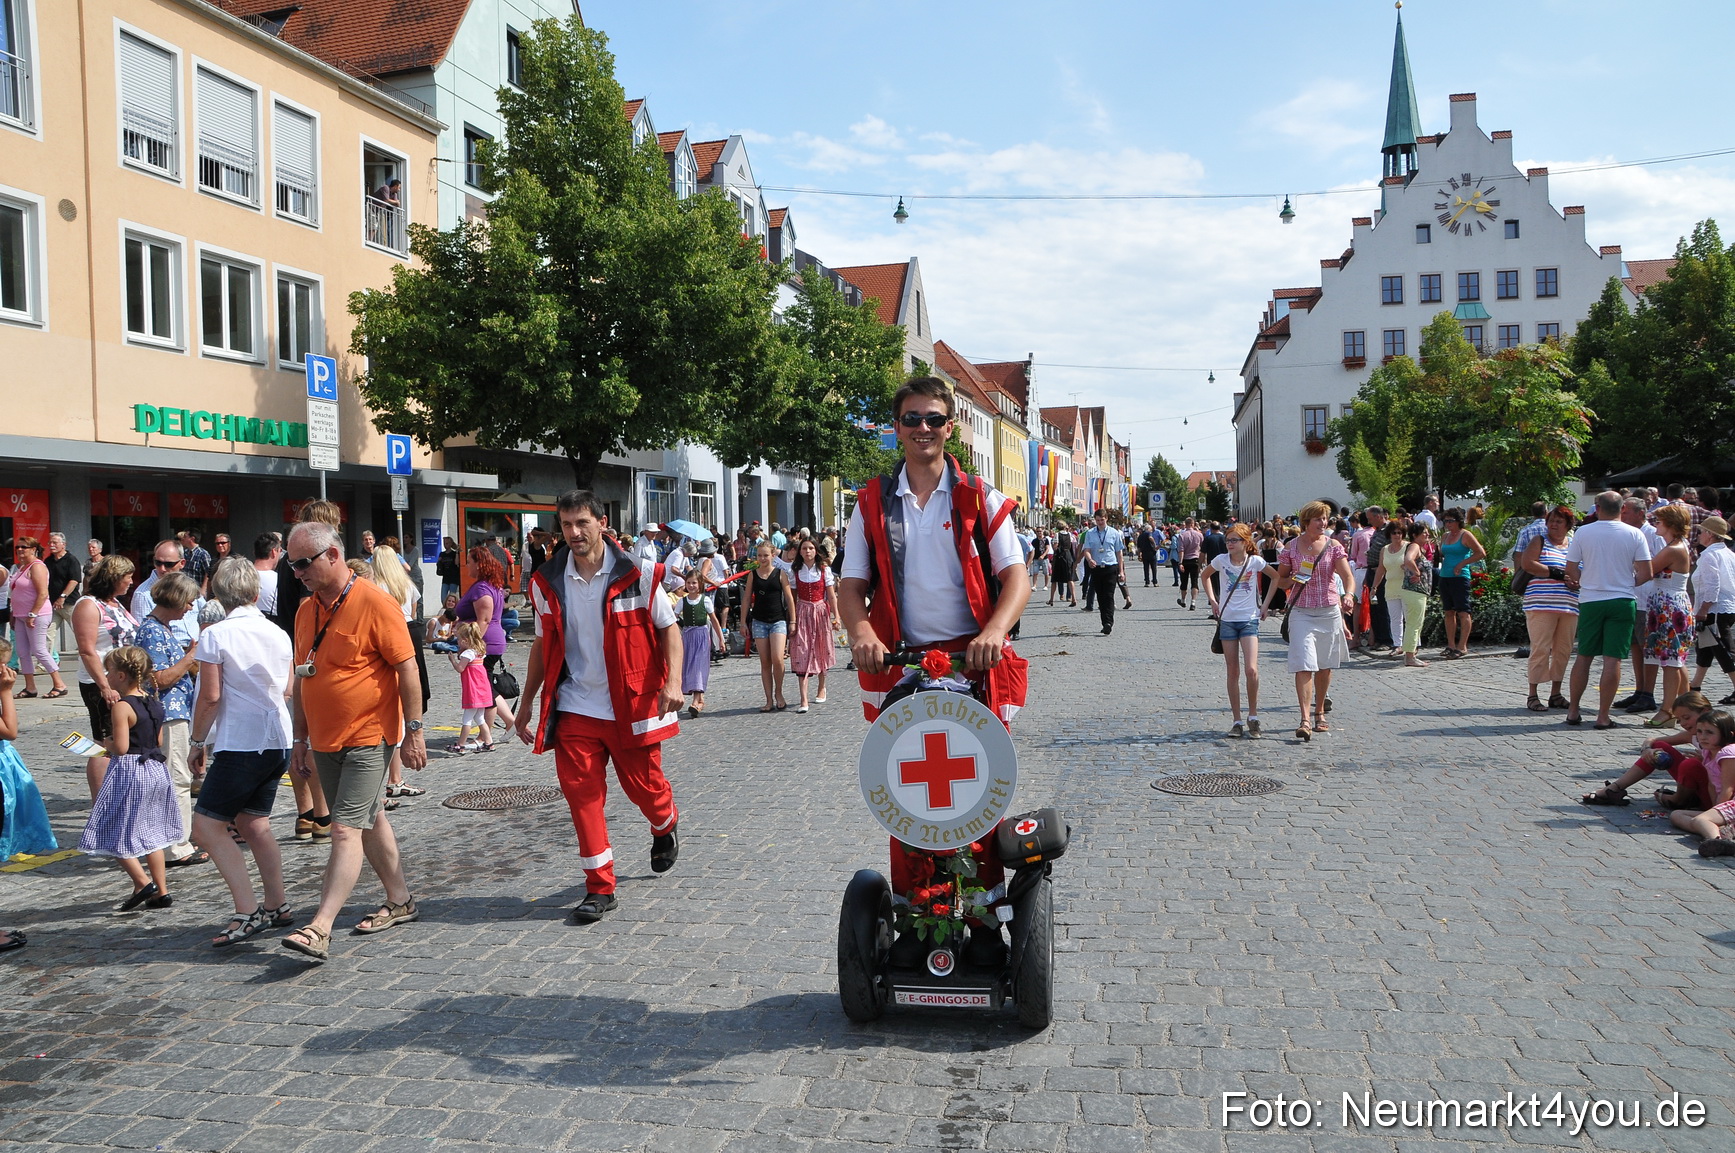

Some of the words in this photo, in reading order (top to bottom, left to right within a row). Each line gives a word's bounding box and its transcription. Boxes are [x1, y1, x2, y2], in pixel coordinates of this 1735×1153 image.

[313, 360, 330, 393] P
[311, 411, 335, 419] Parkschein
[391, 440, 406, 470] P
[880, 704, 914, 736] 125
[923, 695, 989, 730] Jahre
[919, 777, 1011, 844] Neumarkt
[908, 994, 987, 1005] E-GRINGOS.DE
